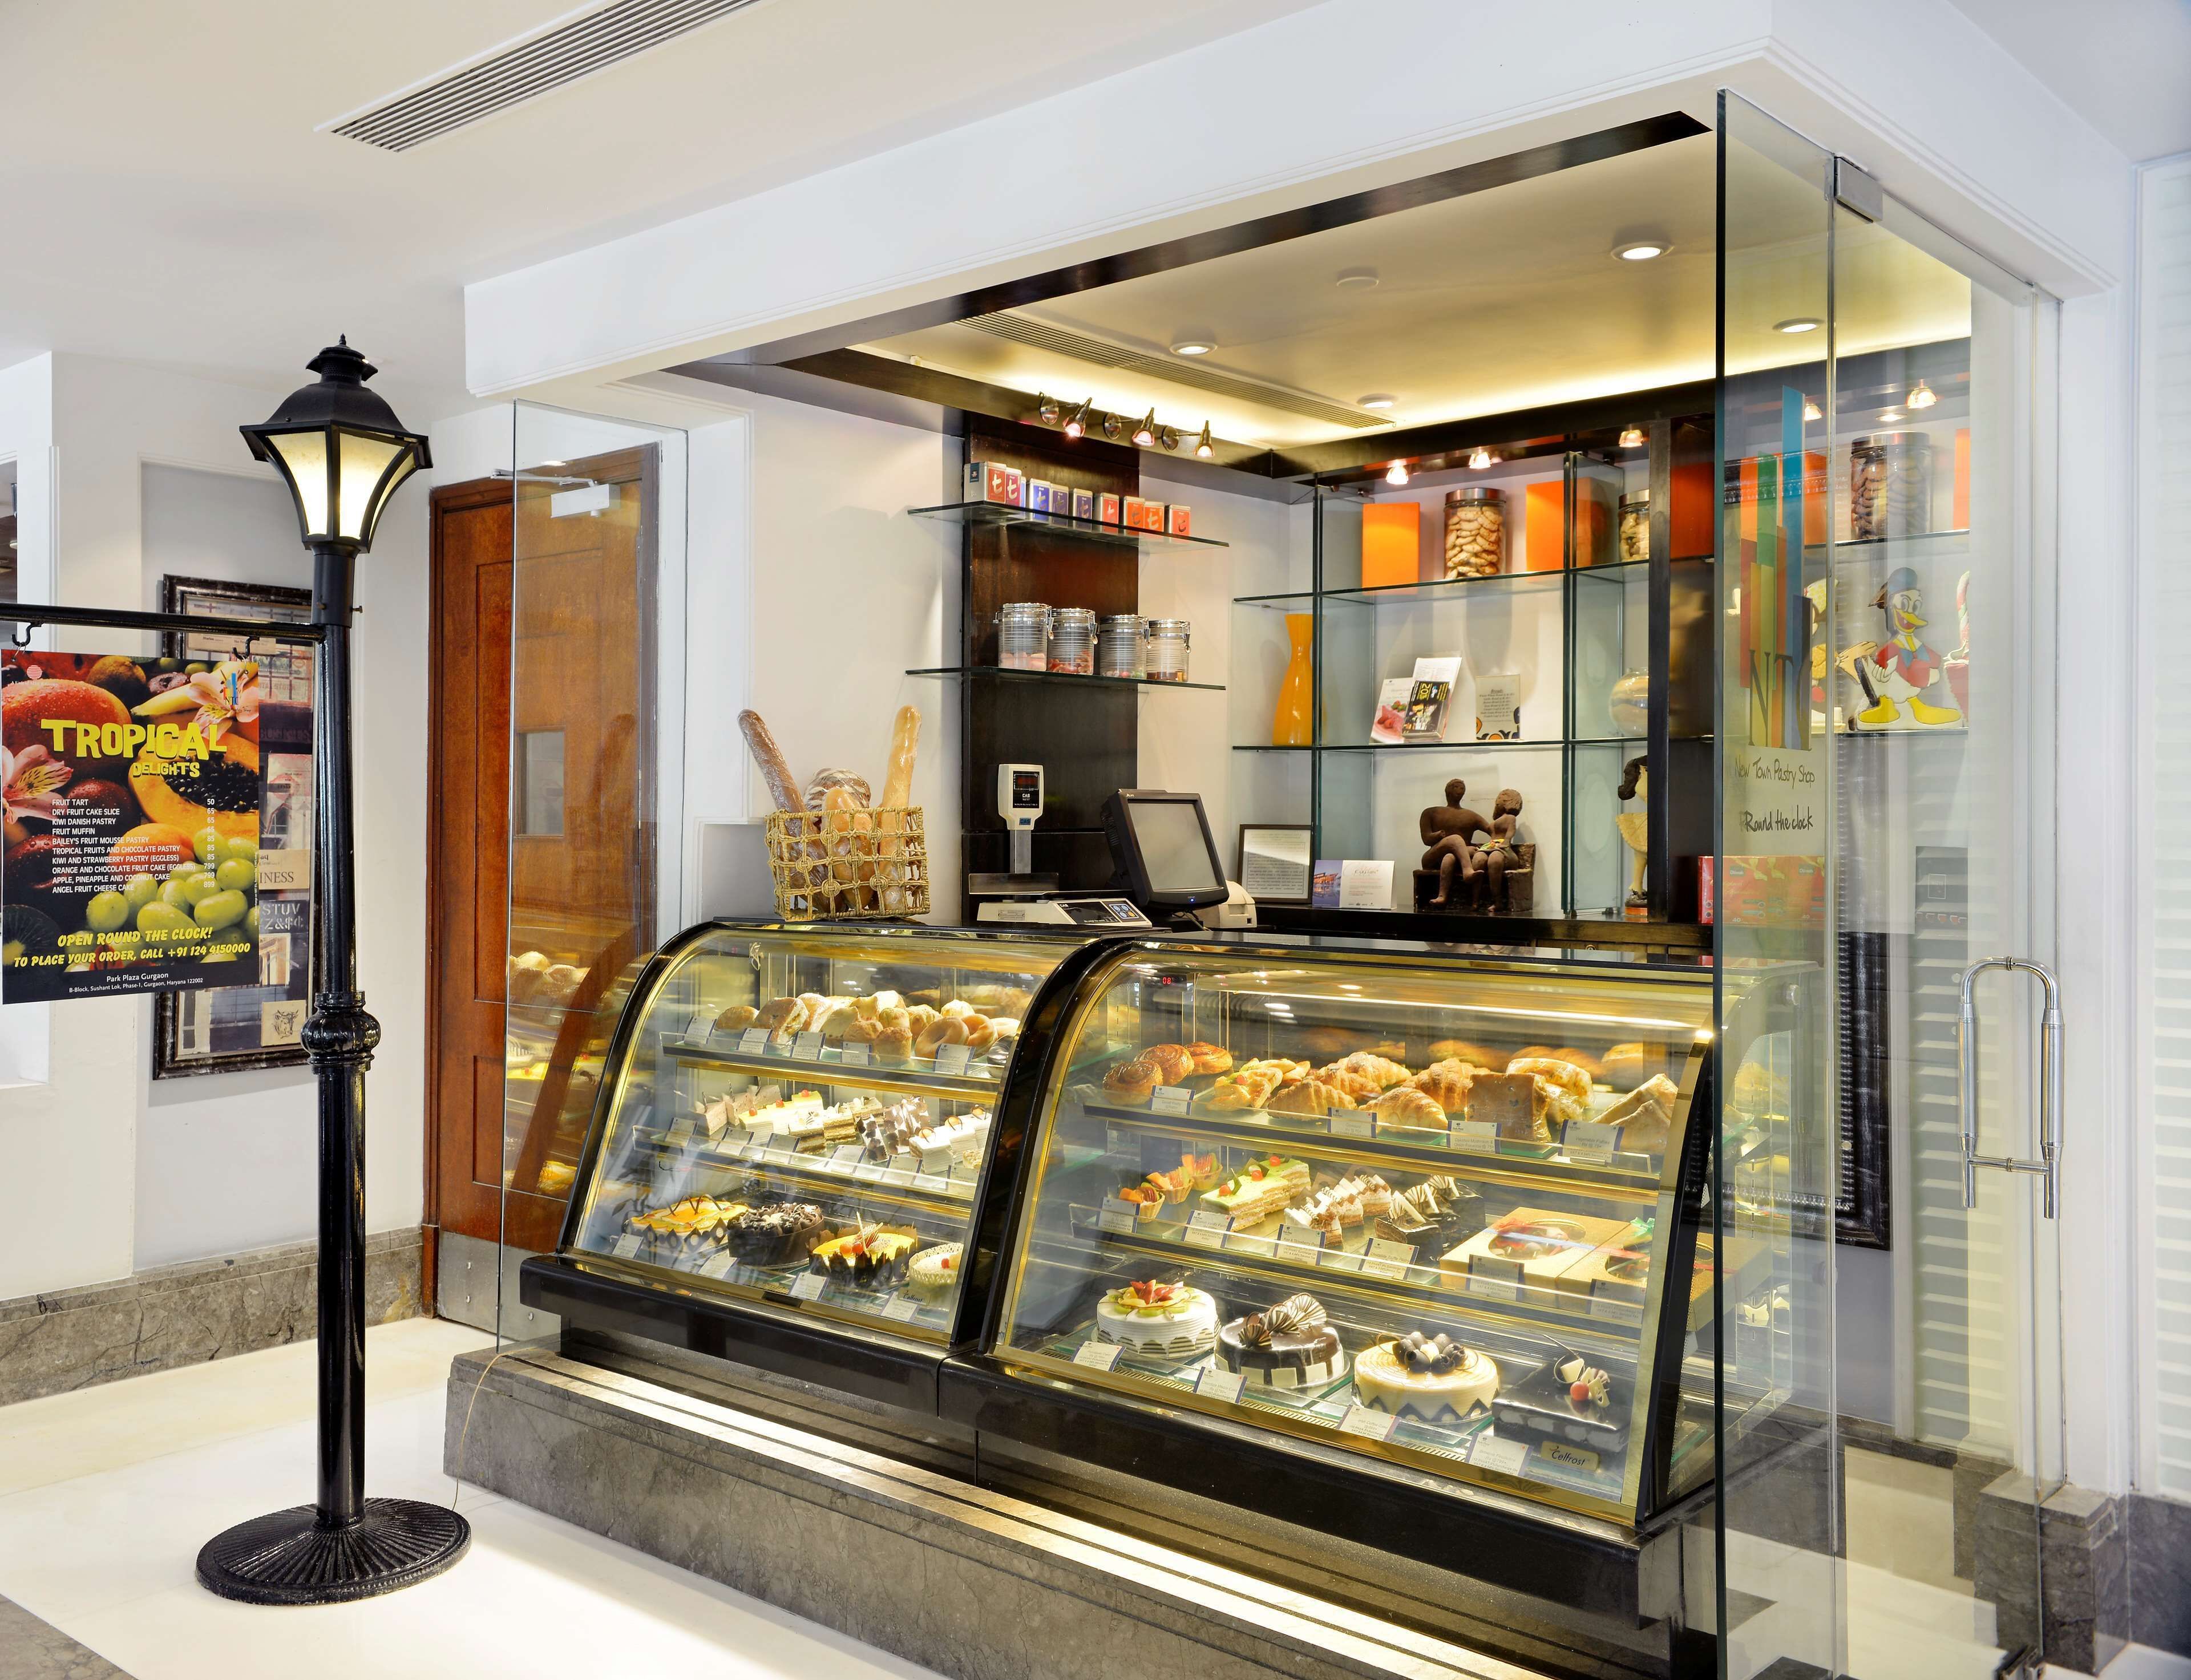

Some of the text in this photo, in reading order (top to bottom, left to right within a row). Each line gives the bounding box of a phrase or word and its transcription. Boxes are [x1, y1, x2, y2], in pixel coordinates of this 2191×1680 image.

[41, 719, 228, 760] TROPICAL
[132, 762, 200, 778] DELIGHTS
[1735, 755, 1816, 790] New Town Pastry Shop
[1744, 804, 1813, 832] Round the clock
[259, 872, 294, 883] INESS
[262, 903, 300, 915] STUV
[57, 926, 213, 947] OPEN ROUND THE CLOCK!
[14, 942, 251, 968] TO PLACE YOUR ORDER, CALL +91 124 4150000
[141, 973, 169, 981] Gurgaon
[1551, 1450, 1586, 1466] Celfrost
